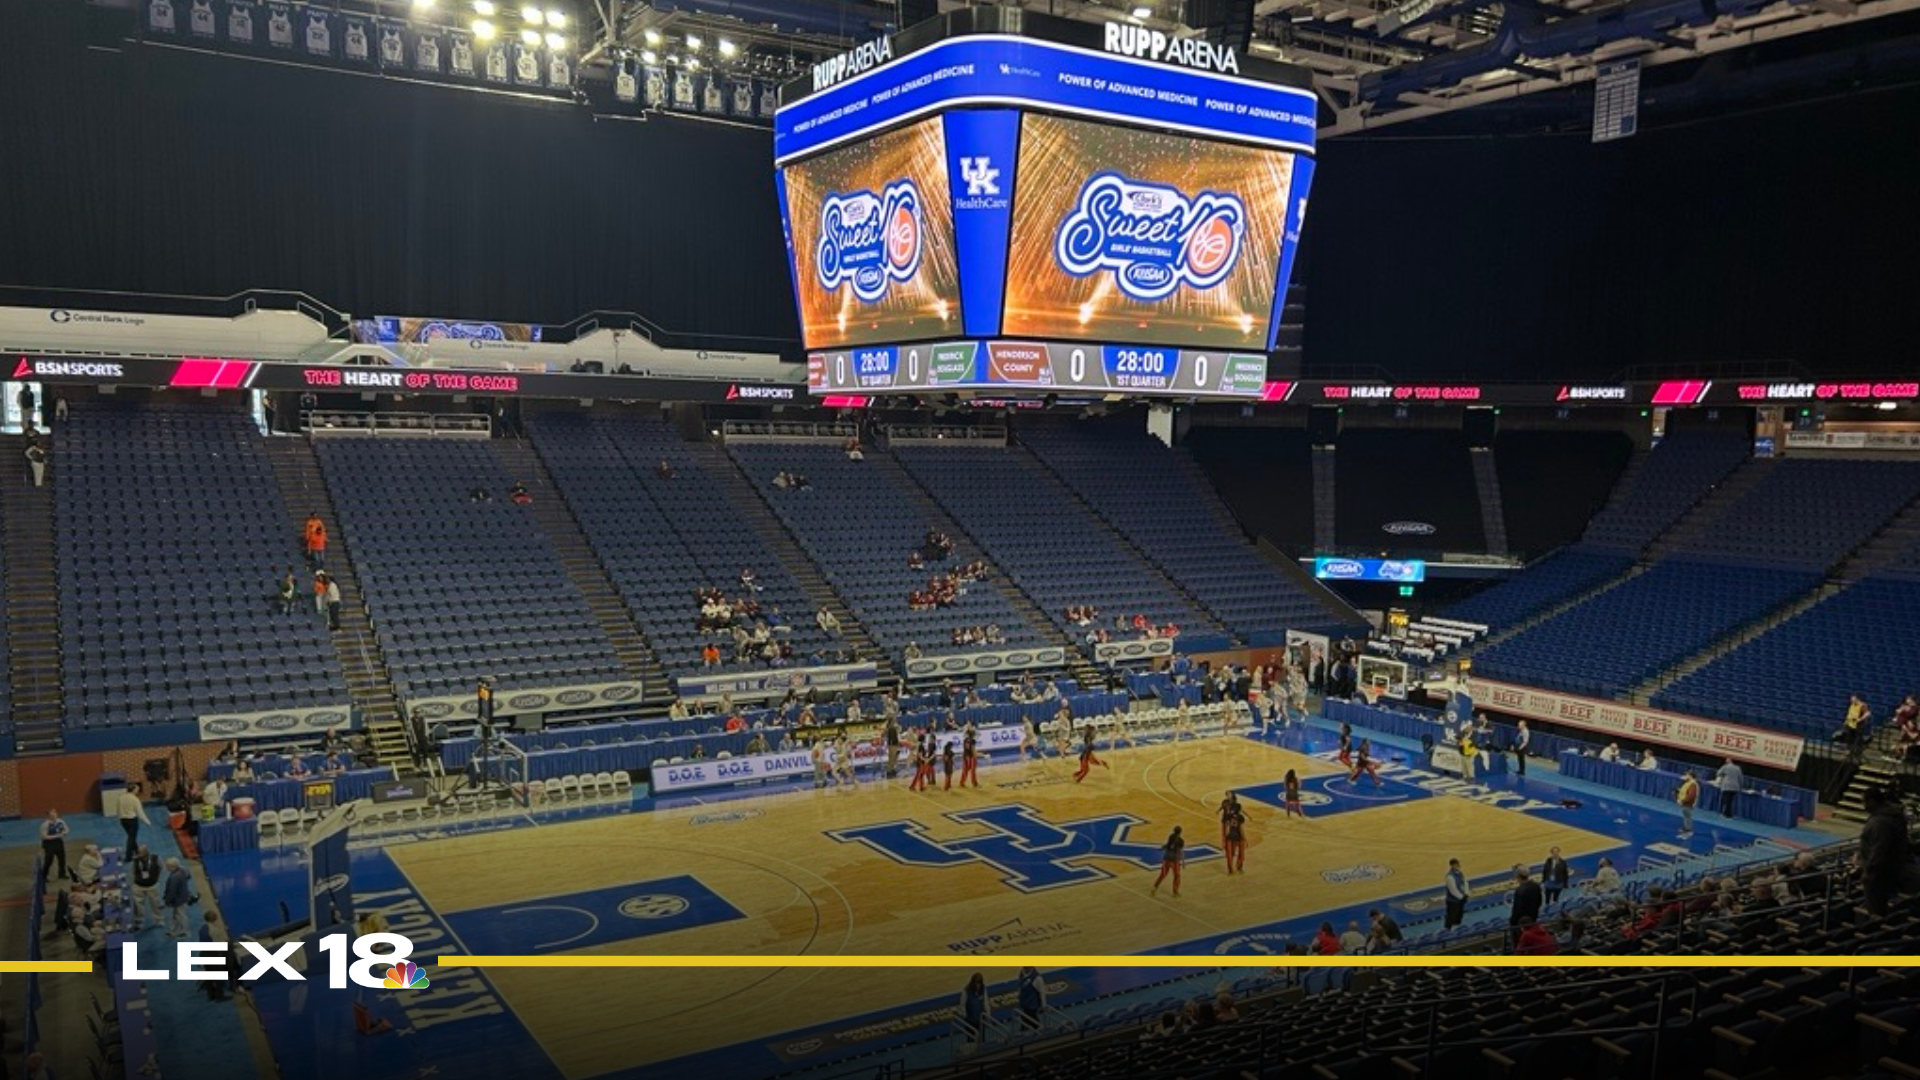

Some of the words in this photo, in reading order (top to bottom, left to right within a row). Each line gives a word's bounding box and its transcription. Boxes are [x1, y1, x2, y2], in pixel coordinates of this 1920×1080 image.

[1104, 21, 1166, 60] RUPP
[1166, 36, 1239, 75] ARENA
[813, 54, 846, 91] RUPP
[846, 35, 892, 77] ARENA
[871, 91, 891, 104] POWER
[892, 87, 900, 97] OF
[901, 75, 932, 93] ADVANCED
[933, 64, 974, 80] MEDICINE
[1059, 72, 1092, 88] POWER
[1094, 78, 1106, 90] OF
[1108, 81, 1156, 99] ADVANCED
[1158, 89, 1198, 106] MEDICINE
[1205, 99, 1234, 113] POWER
[1236, 103, 1248, 115] OF
[1249, 106, 1290, 122] ADVANCED
[959, 157, 1000, 195] UK
[956, 198, 1008, 209] HealthCare
[1068, 188, 1179, 261] Sweet
[822, 205, 879, 278] Sweet
[1132, 245, 1172, 257] BASKETBALL
[1133, 268, 1164, 281] KHSAA
[73, 314, 101, 323] Central
[103, 315, 123, 324] Bank
[124, 317, 144, 325] Logo
[860, 352, 889, 372] 28:00
[996, 350, 1040, 361] HENDERSON
[1117, 351, 1164, 373] 28:00
[35, 362, 69, 376] BSN
[69, 363, 123, 377] SPORTS
[836, 355, 845, 385] 0
[908, 350, 918, 382] 0
[1003, 362, 1033, 372] COUNTY
[1070, 349, 1085, 382] 0
[1194, 356, 1207, 386] 0
[305, 370, 341, 385] THE
[344, 373, 402, 387] HEART
[406, 374, 431, 387] OF
[434, 374, 467, 388] THE
[470, 376, 517, 391] GAME
[1117, 375, 1129, 386] 1ST
[1131, 376, 1165, 388] QUARTER
[739, 387, 761, 398] BSN
[762, 388, 793, 399] SPORTS
[1324, 387, 1349, 398] THE
[1351, 387, 1392, 398] HEART
[1393, 387, 1412, 398] OF
[1413, 387, 1440, 398] THE
[1441, 387, 1480, 398] GAME
[1593, 388, 1625, 399] SPORTS
[1739, 386, 1766, 398] THE
[1768, 384, 1815, 398] HEART
[1816, 384, 1839, 397] OF
[1840, 384, 1870, 397] THE
[1872, 383, 1919, 397] GAME
[1327, 564, 1358, 573] KHSAA
[1493, 690, 1526, 706] BEEF
[1560, 703, 1595, 719] BEEF
[1633, 717, 1672, 735] BEEF
[1713, 733, 1758, 751] BEEF
[717, 762, 753, 776] D.O.E.
[764, 755, 811, 772] DANVIL
[823, 803, 1224, 894] UK
[947, 934, 1002, 952] RUPP
